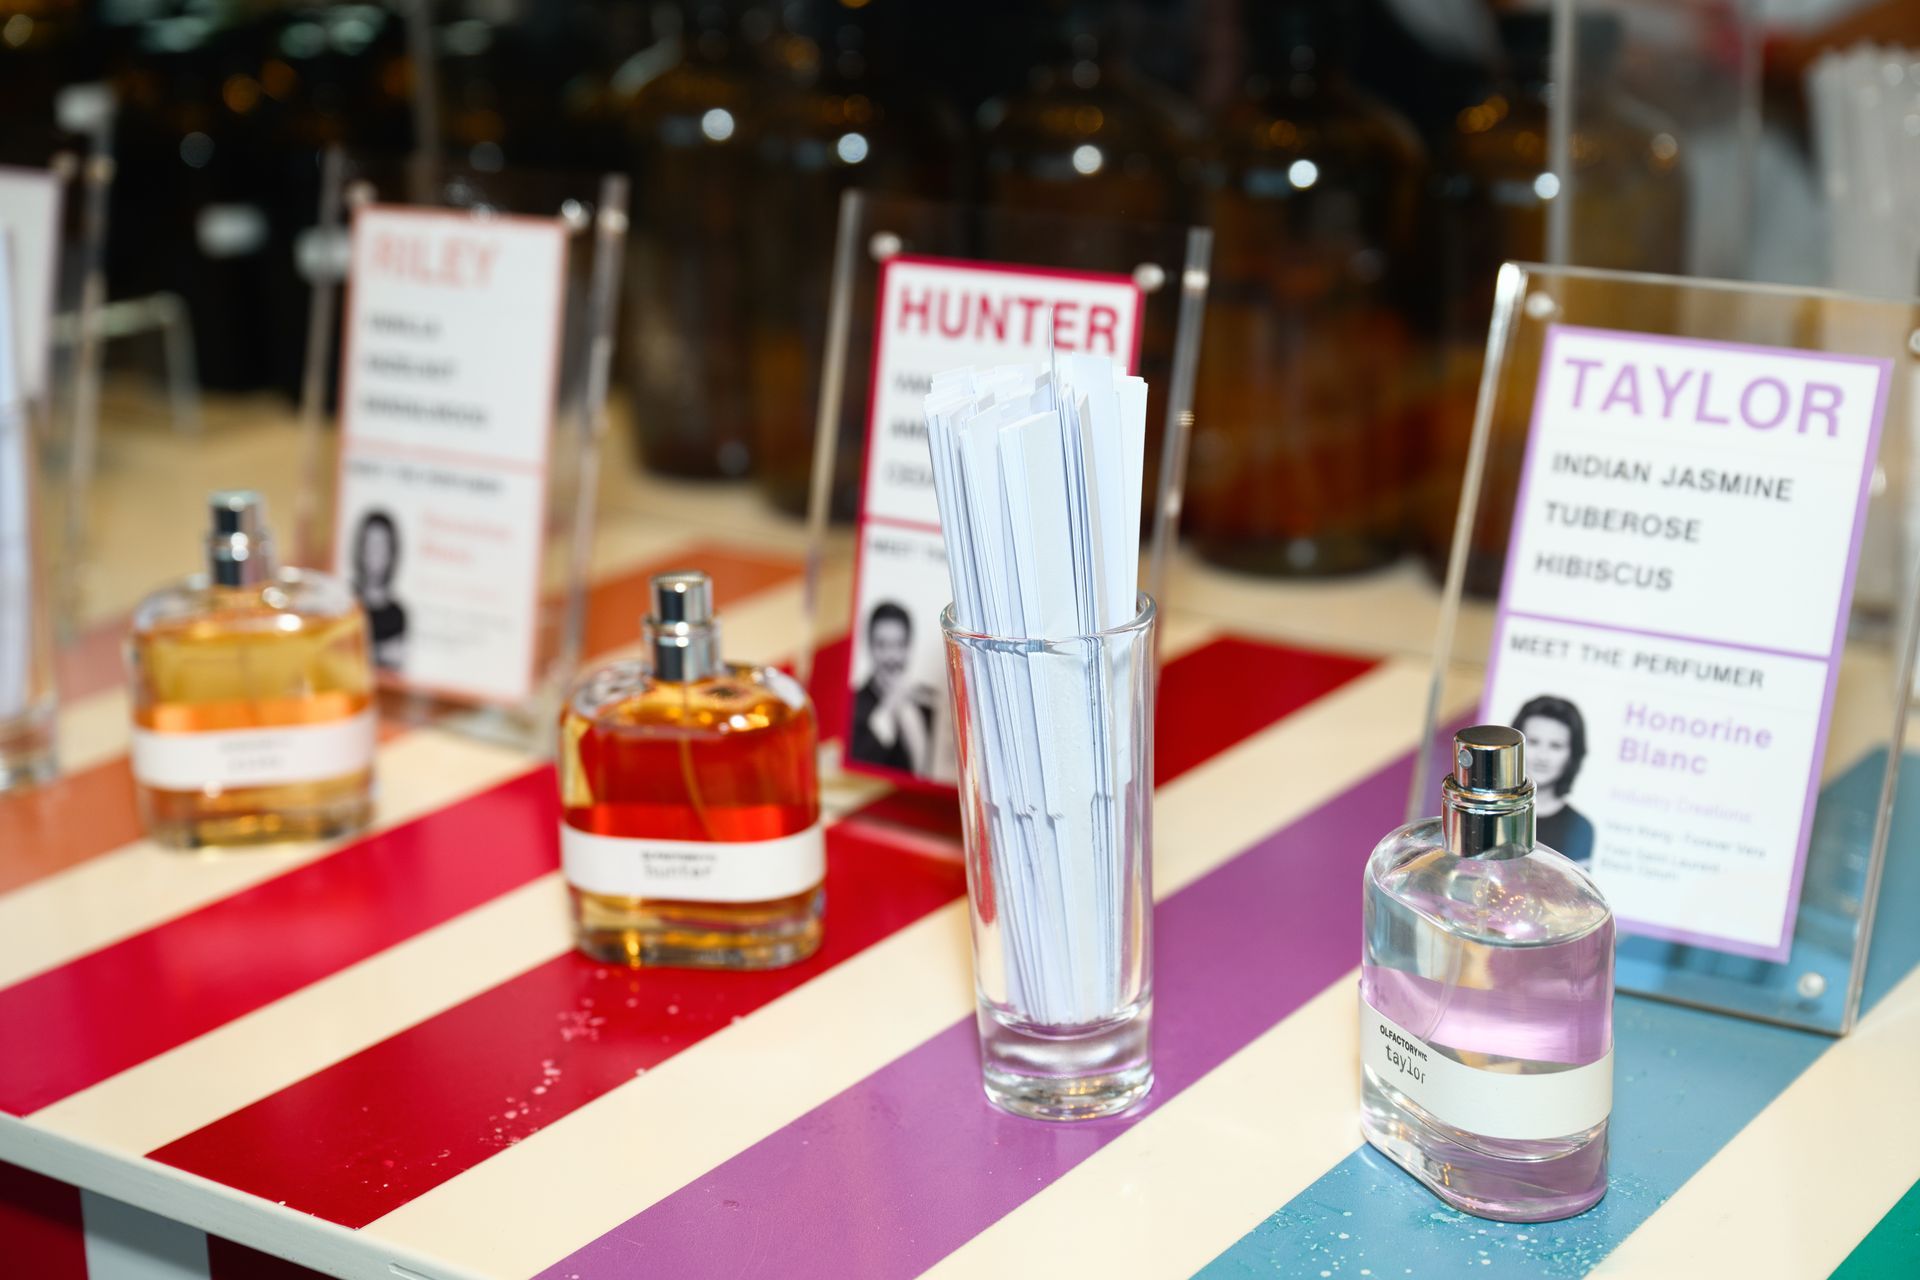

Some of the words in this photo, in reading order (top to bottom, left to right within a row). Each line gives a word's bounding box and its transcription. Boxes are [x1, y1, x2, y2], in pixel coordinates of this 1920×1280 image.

[371, 231, 502, 291] RILEY
[896, 287, 1120, 354] HUNTER
[1563, 356, 1845, 438] TAYLOR
[1551, 451, 1652, 485] INDIAN
[1660, 465, 1796, 502] JASMINE
[1544, 501, 1702, 543] TUBEROSE
[1533, 552, 1675, 592] HIBISCUS
[1509, 633, 1570, 661] MEET
[1580, 643, 1622, 668] THE
[1632, 650, 1766, 688] PERFUMER
[1623, 701, 1774, 750] Honorine
[1617, 736, 1709, 776] Blanc
[1385, 1044, 1426, 1084] taylor
